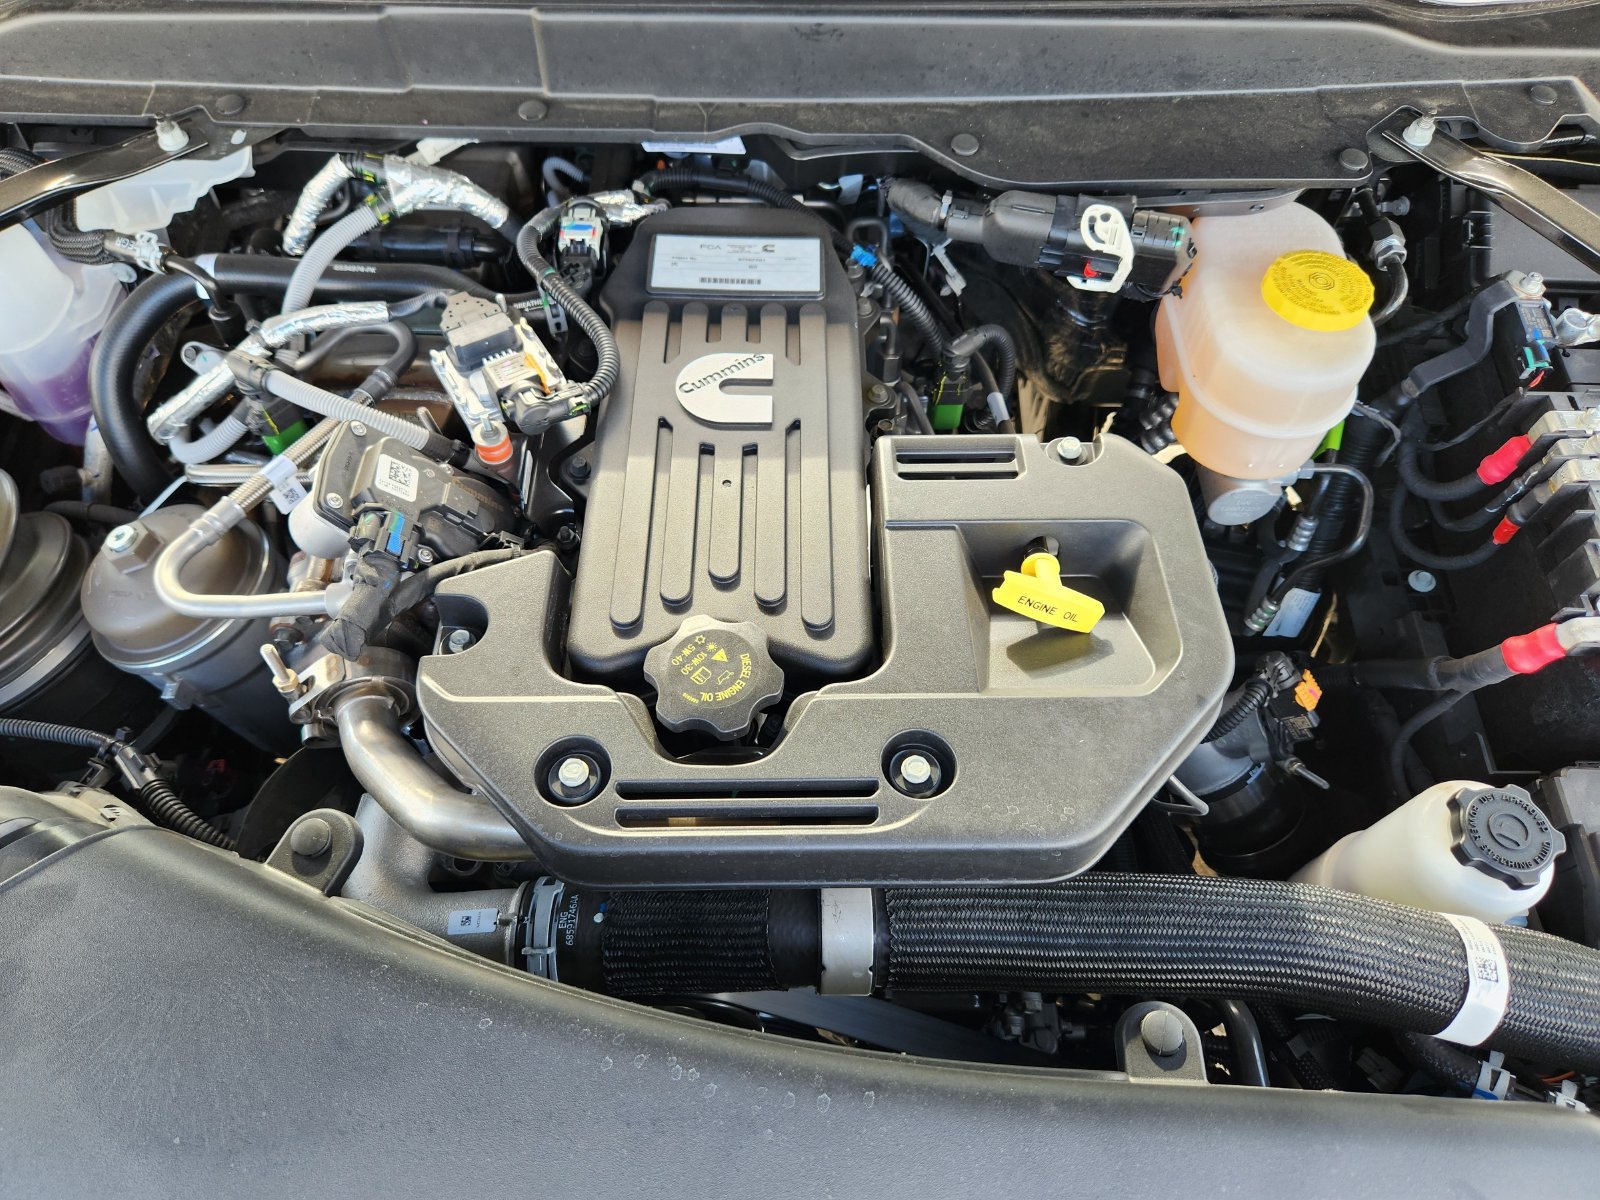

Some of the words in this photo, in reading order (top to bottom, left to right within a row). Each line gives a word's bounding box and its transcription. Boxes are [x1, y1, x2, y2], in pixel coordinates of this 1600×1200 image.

[678, 354, 765, 394] Cummins
[1017, 595, 1058, 616] ENGINE
[1063, 611, 1078, 623] OIL
[671, 643, 696, 666] 5W-40
[680, 651, 708, 675] 10W-30
[740, 652, 752, 679] DIESEL
[700, 691, 714, 702] OIL
[714, 679, 746, 702] ENGINE
[1478, 793, 1496, 805] USE
[1501, 794, 1549, 833] APPROVED
[1480, 843, 1533, 869] STEERING
[558, 911, 569, 929] ENG
[565, 894, 580, 946] 68591746AA
